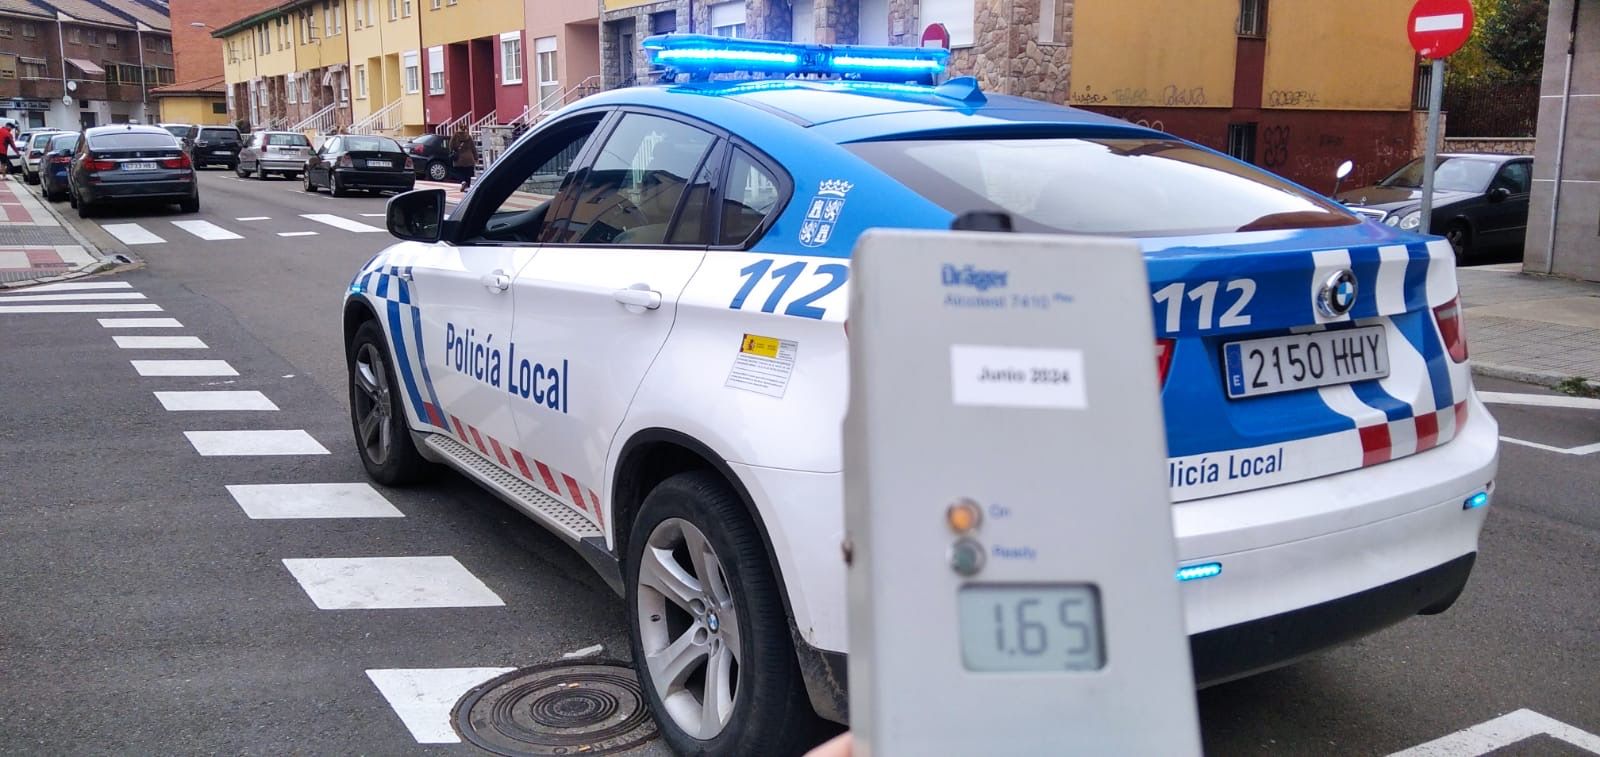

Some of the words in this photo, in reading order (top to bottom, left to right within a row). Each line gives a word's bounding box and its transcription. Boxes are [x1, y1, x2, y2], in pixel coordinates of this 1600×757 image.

[729, 258, 848, 320] 112
[941, 263, 1008, 291] Dräger
[1153, 278, 1257, 333] 112
[446, 322, 501, 389] Policía
[508, 342, 569, 413] Local
[977, 365, 1026, 383] Junio
[1031, 366, 1070, 385] 2024
[1233, 374, 1242, 387] E
[1250, 341, 1325, 389] 2150
[1331, 333, 1381, 378] HHY
[1170, 458, 1219, 488] licía
[1229, 448, 1283, 479] Local
[989, 506, 1010, 518] On
[991, 546, 1036, 560] Ready
[993, 598, 1090, 656] 1.65
